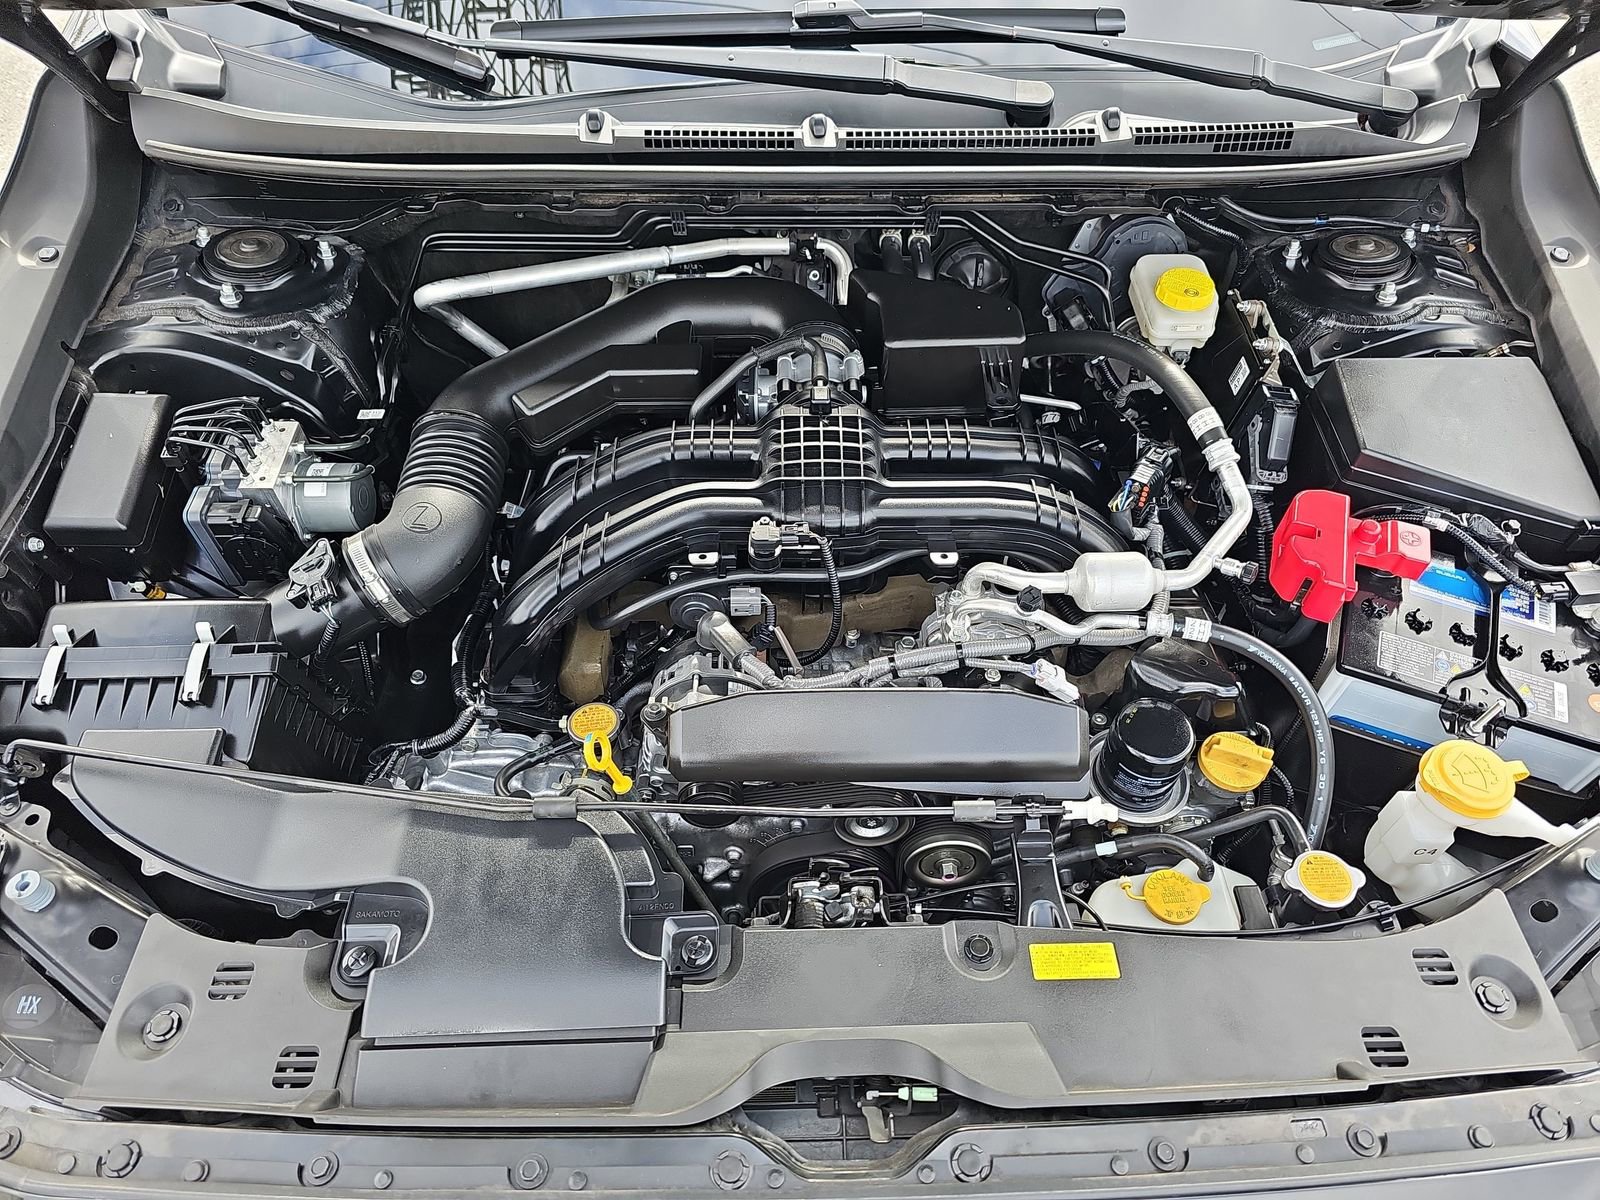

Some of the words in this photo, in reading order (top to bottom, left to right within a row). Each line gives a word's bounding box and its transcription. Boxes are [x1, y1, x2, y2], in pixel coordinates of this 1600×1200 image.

[1435, 569, 1467, 582] SUBARU
[1255, 648, 1288, 676] YOKOHAMA
[1316, 729, 1324, 743] HP
[1413, 848, 1438, 856] C4
[1147, 871, 1192, 890] COOLANT
[355, 910, 400, 919] SAKAMOTO
[16, 995, 42, 1014] HX
